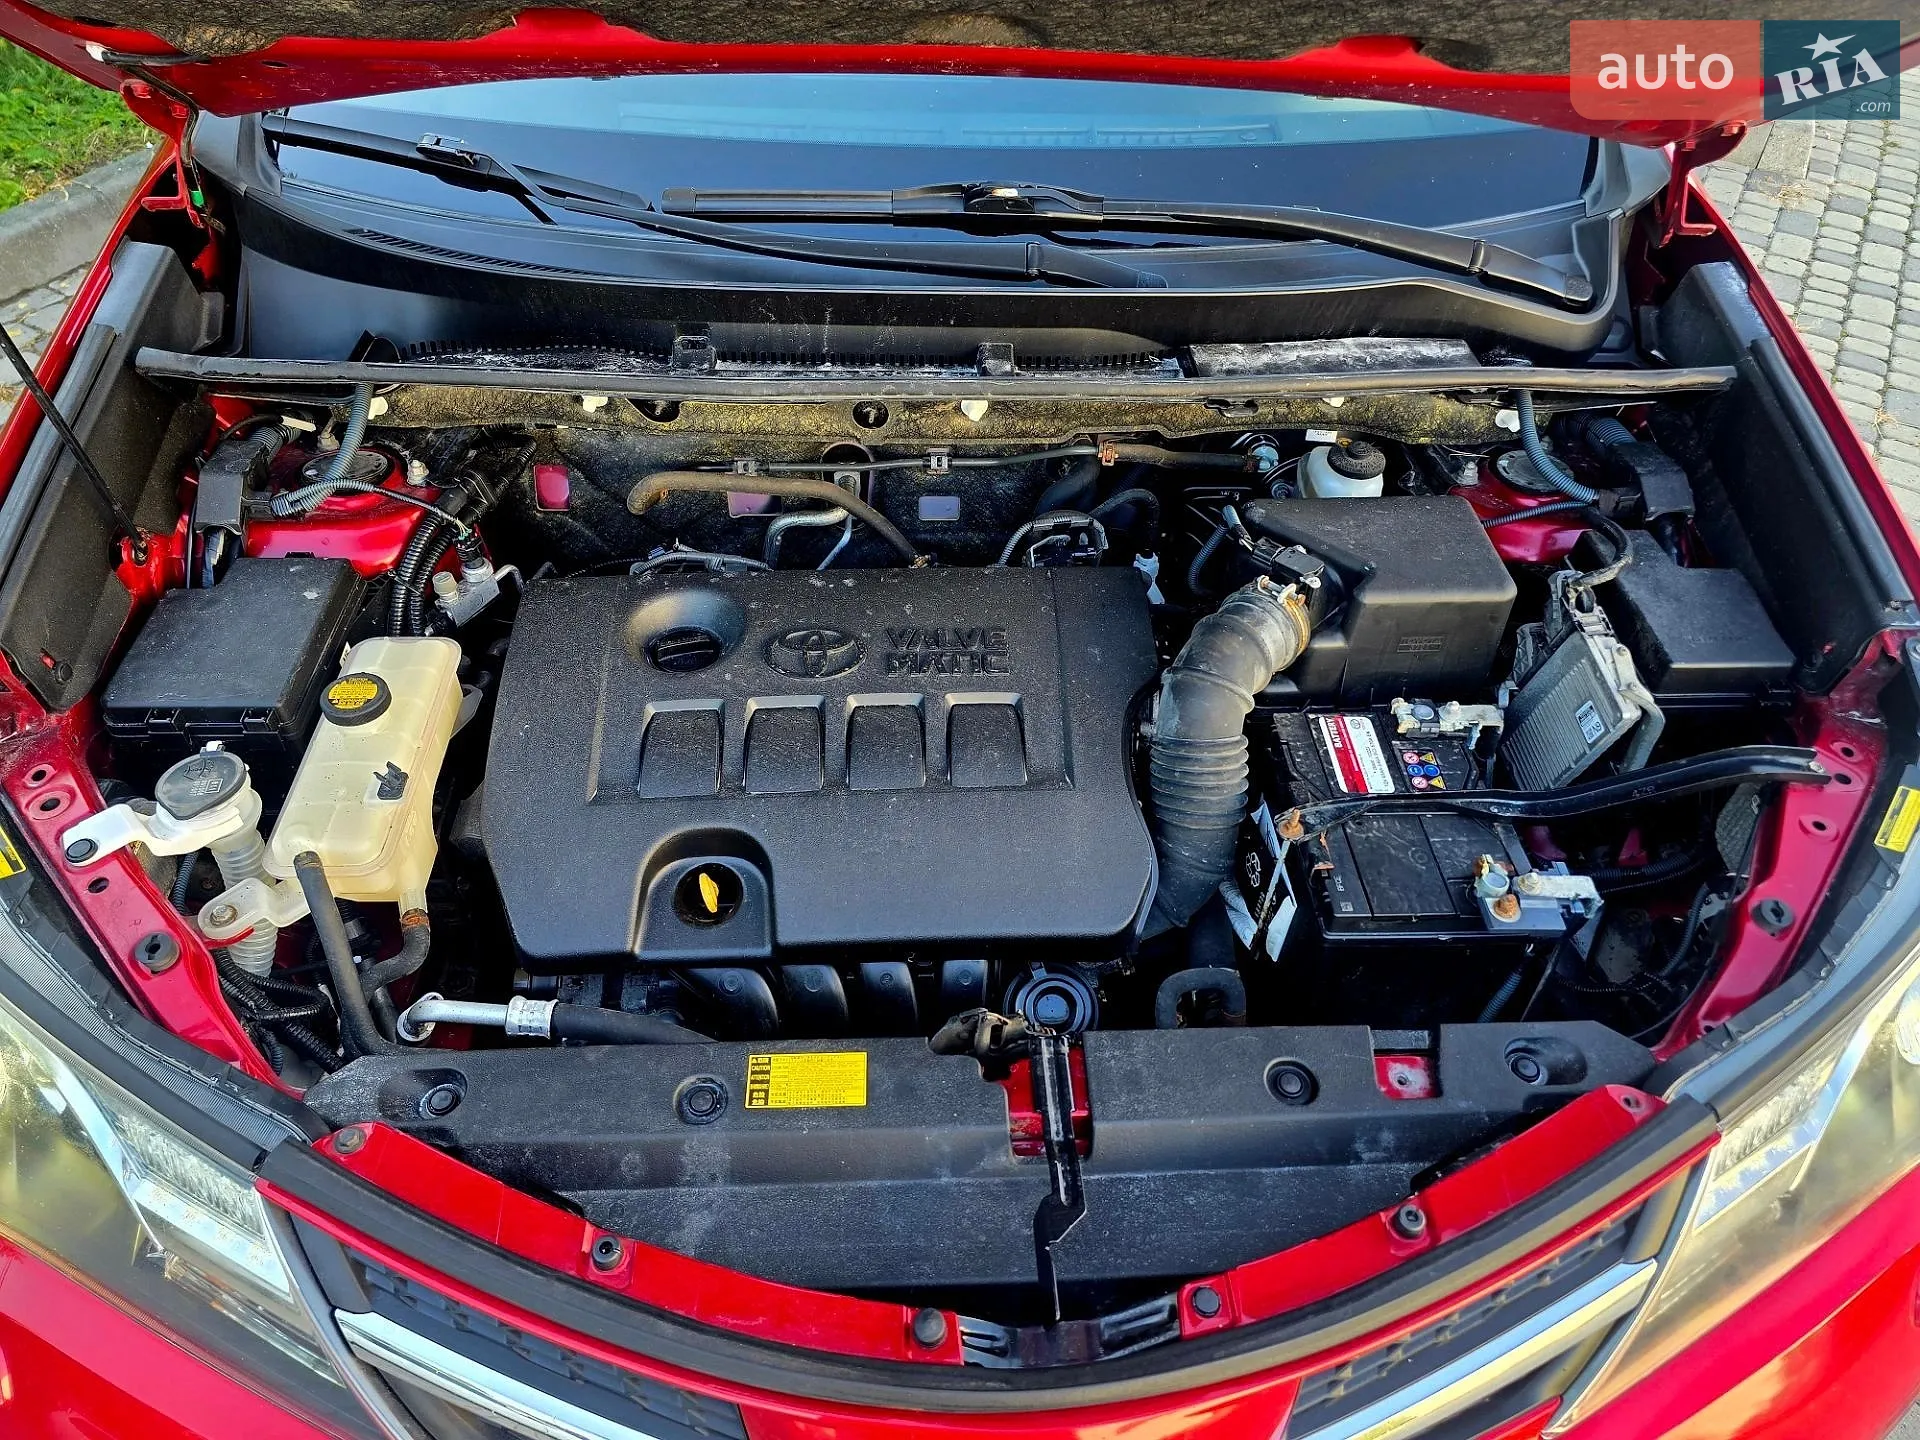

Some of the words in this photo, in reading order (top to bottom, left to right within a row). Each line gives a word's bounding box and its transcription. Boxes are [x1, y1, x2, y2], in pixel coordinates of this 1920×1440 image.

[885, 627, 1008, 651] VALVE
[886, 651, 1010, 677] MATIC
[1325, 717, 1343, 748] BATTERY
